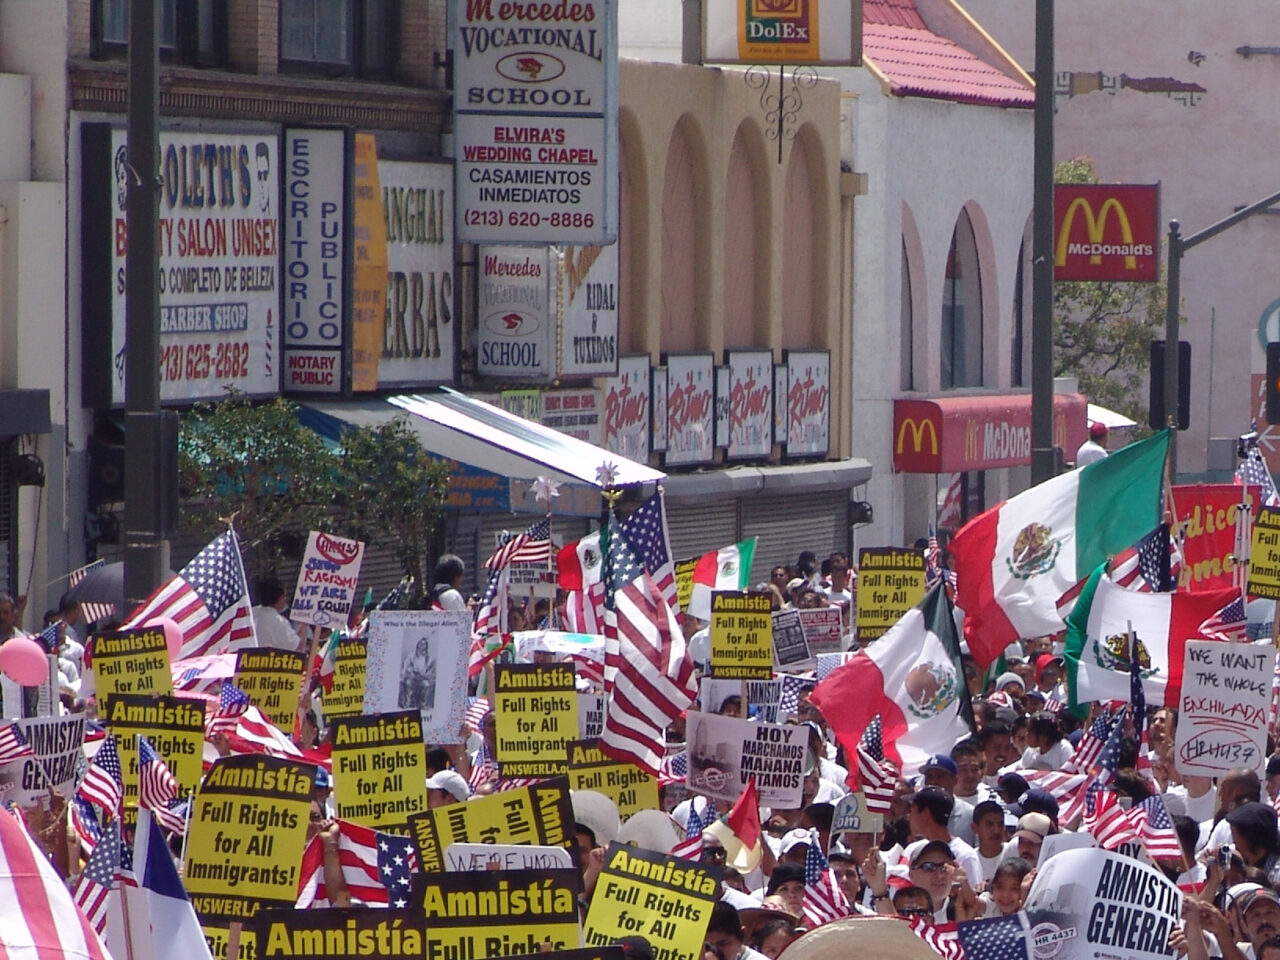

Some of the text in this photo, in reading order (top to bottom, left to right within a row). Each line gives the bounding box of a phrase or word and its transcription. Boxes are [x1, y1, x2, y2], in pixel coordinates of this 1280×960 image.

[466, 0, 596, 22] Mercedes
[749, 20, 808, 40] DolEx
[459, 27, 602, 62] VOCATIONAL
[468, 87, 591, 106] SCHOOL
[494, 127, 565, 143] ELVIRA'S
[463, 146, 598, 164] WEDDING CHAPEL
[160, 143, 251, 208] OLETH'S
[469, 168, 591, 185] CASAMIENTOS
[479, 188, 581, 204] INMEDIATOS
[464, 209, 503, 227] (213)
[178, 218, 277, 257] SALON UNISEX
[287, 138, 309, 340] ESCRITORIO
[1068, 241, 1153, 257] McDonald's
[318, 202, 338, 340] PUBLICO
[484, 254, 541, 278] Mercedes
[170, 265, 275, 294] COMPLETO DE BELLEZA
[161, 304, 247, 331] BARBER SHOP
[186, 342, 248, 380] 625-2682
[289, 355, 335, 369] NOTARY
[481, 340, 540, 368] SCHOOL
[573, 335, 614, 365] TUXEDOS
[291, 371, 333, 386] PUBLIC
[1258, 532, 1278, 547] Full
[861, 551, 923, 568] Amnistía
[299, 585, 348, 601] WE ARE
[714, 594, 770, 611] Amnistía
[96, 630, 165, 655] Amnistía
[238, 651, 303, 671] Amnistía
[1188, 647, 1268, 672] WE WANT
[500, 668, 574, 689] Amnistía
[1196, 671, 1267, 698] THE WHOLE
[111, 701, 203, 728] Amnistía
[1183, 695, 1267, 728] ENCHILADA
[336, 715, 421, 747] Amnistía
[756, 726, 794, 743] HOY
[742, 739, 804, 758] MARCHAMOS
[339, 750, 418, 777] Full Rights
[740, 753, 801, 775] MAÑANA
[207, 762, 311, 795] Amnistía
[740, 771, 799, 789] VOTAMOS
[337, 798, 425, 822] Immigrants!
[187, 857, 296, 887] Immigrants!
[609, 849, 717, 896] Amnistía
[423, 878, 574, 918] Amnistía
[1095, 858, 1180, 921] AMNISTIA
[265, 920, 422, 957] Amnistía
[1034, 928, 1075, 947] HR 4437
[1086, 901, 1174, 957] GENERAL
